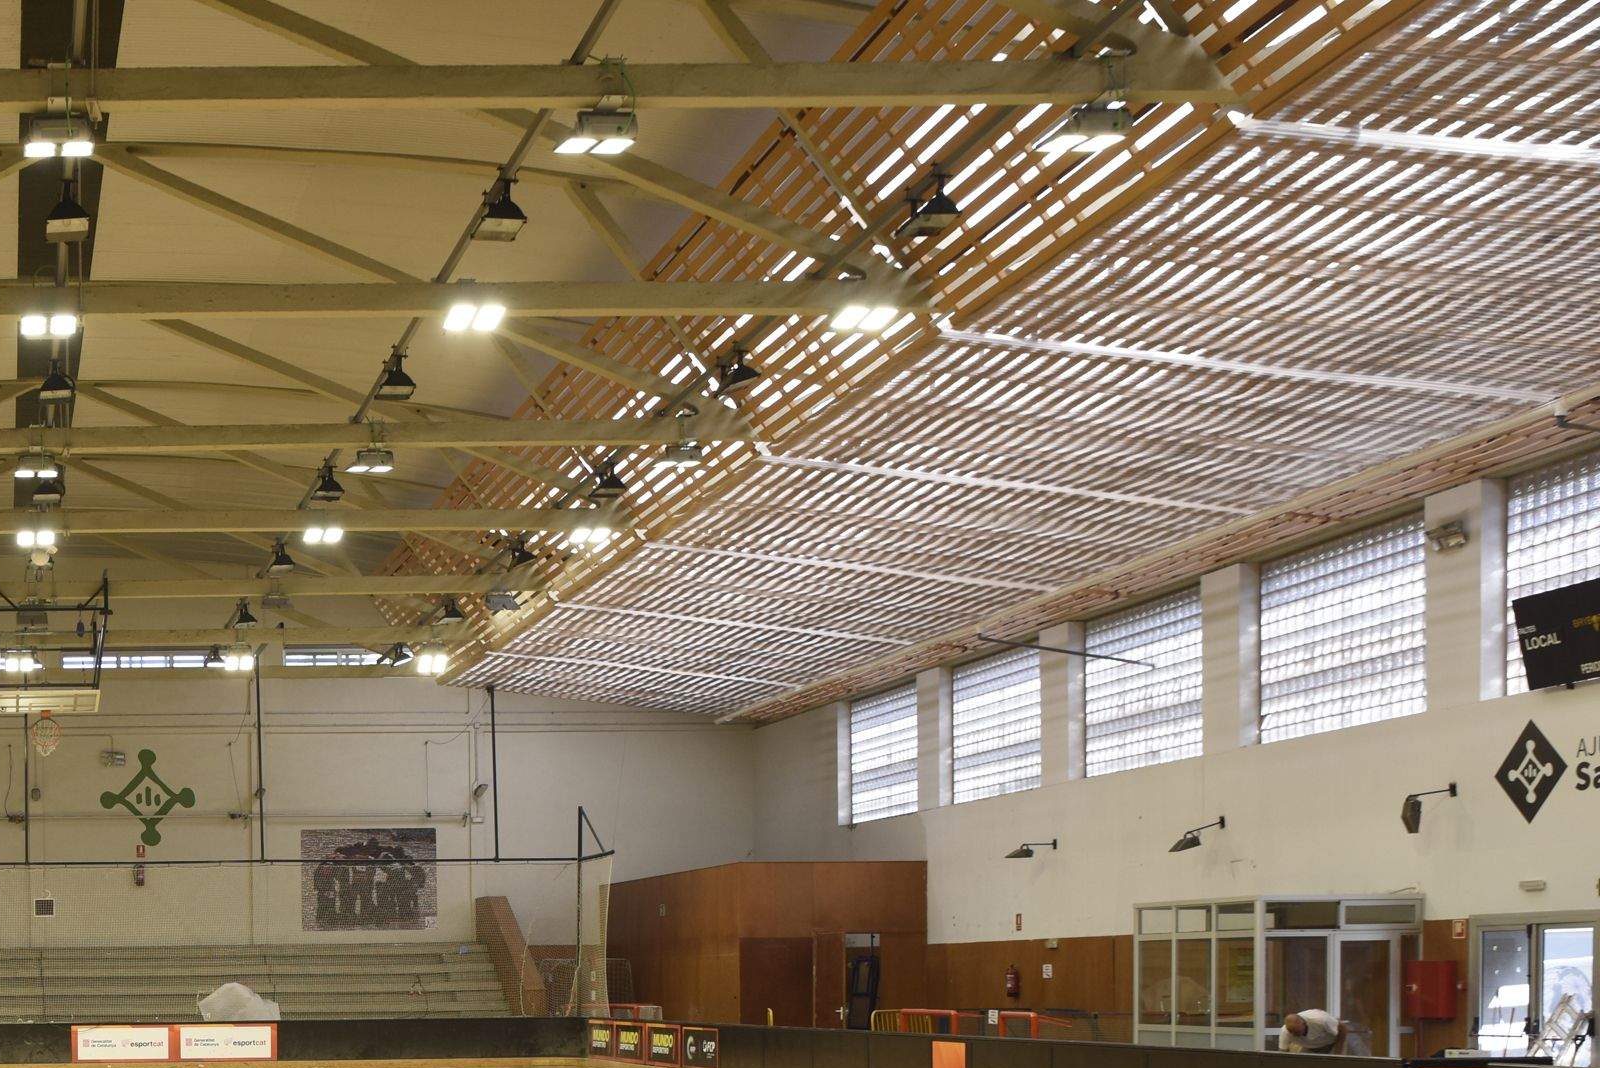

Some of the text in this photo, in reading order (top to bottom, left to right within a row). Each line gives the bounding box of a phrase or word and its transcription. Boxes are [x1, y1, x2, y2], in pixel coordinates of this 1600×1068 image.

[1525, 632, 1562, 650] LOCAL
[593, 1030, 609, 1042] MUNDO
[620, 1032, 638, 1044] MUNDO
[653, 1034, 673, 1047] MUNDO
